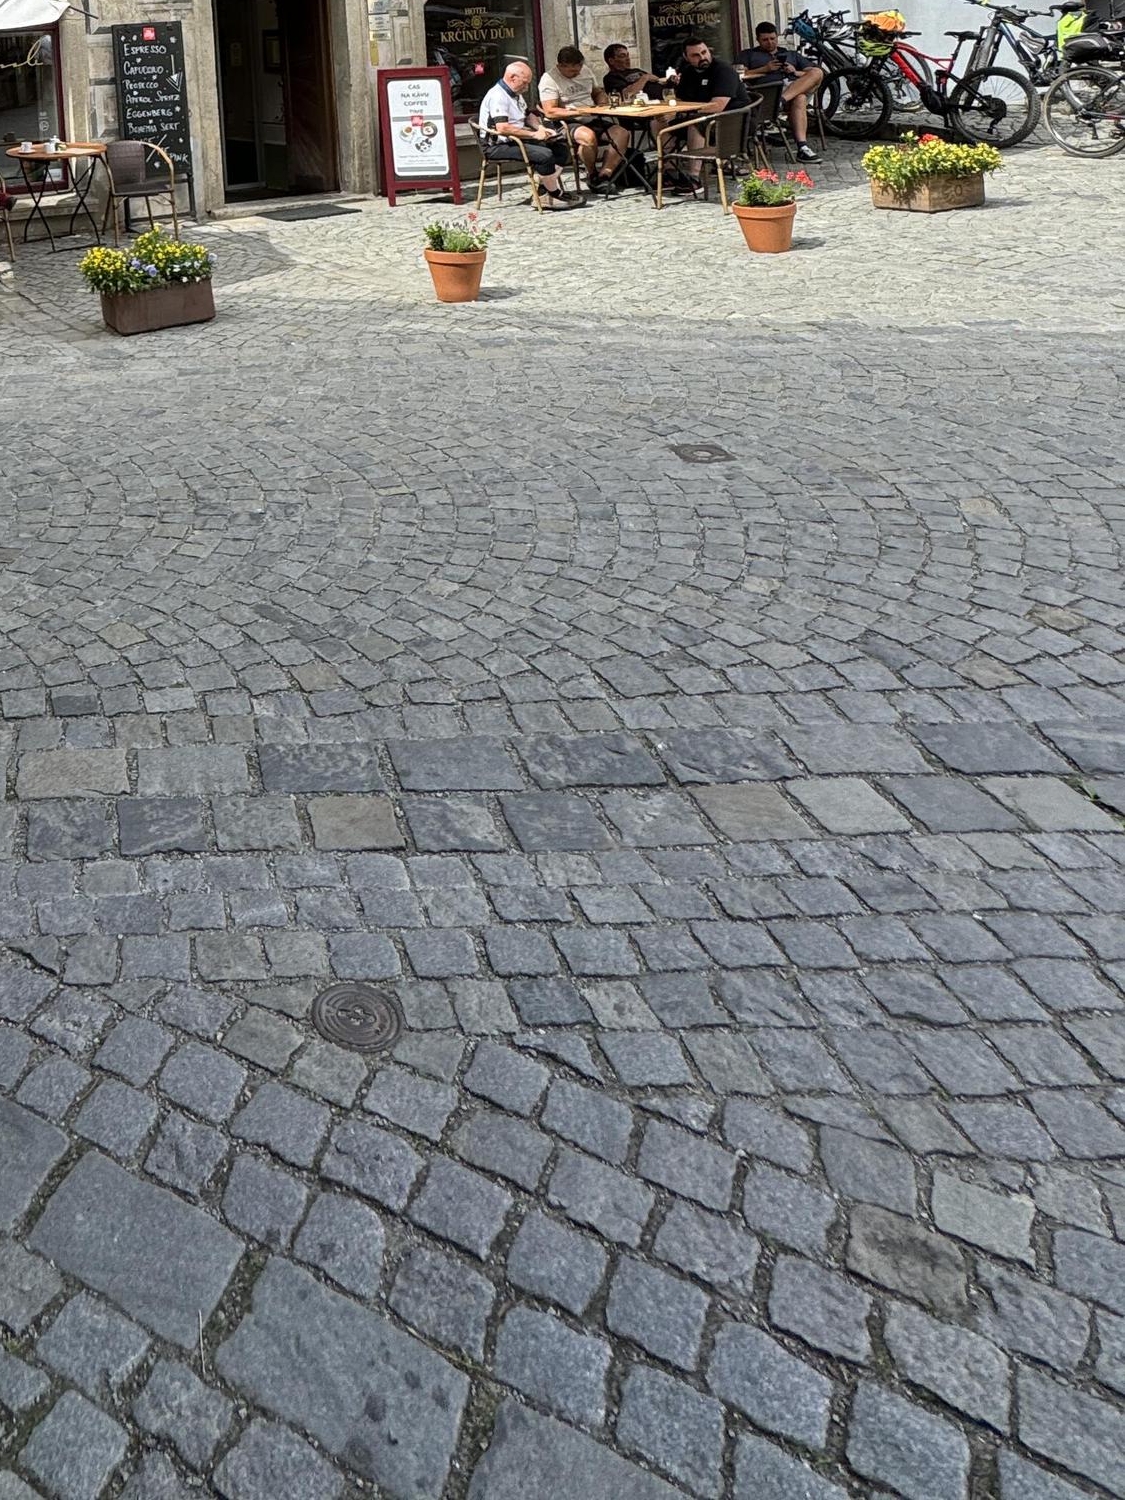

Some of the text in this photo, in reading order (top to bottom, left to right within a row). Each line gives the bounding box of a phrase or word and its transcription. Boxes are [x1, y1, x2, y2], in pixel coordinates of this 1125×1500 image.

[464, 6, 488, 15] HOTEL
[123, 43, 167, 56] ESPRESSO
[123, 79, 159, 90] PROSECCO
[125, 90, 180, 104] APEROL SPRITZ
[126, 107, 173, 119] EGGENBERG
